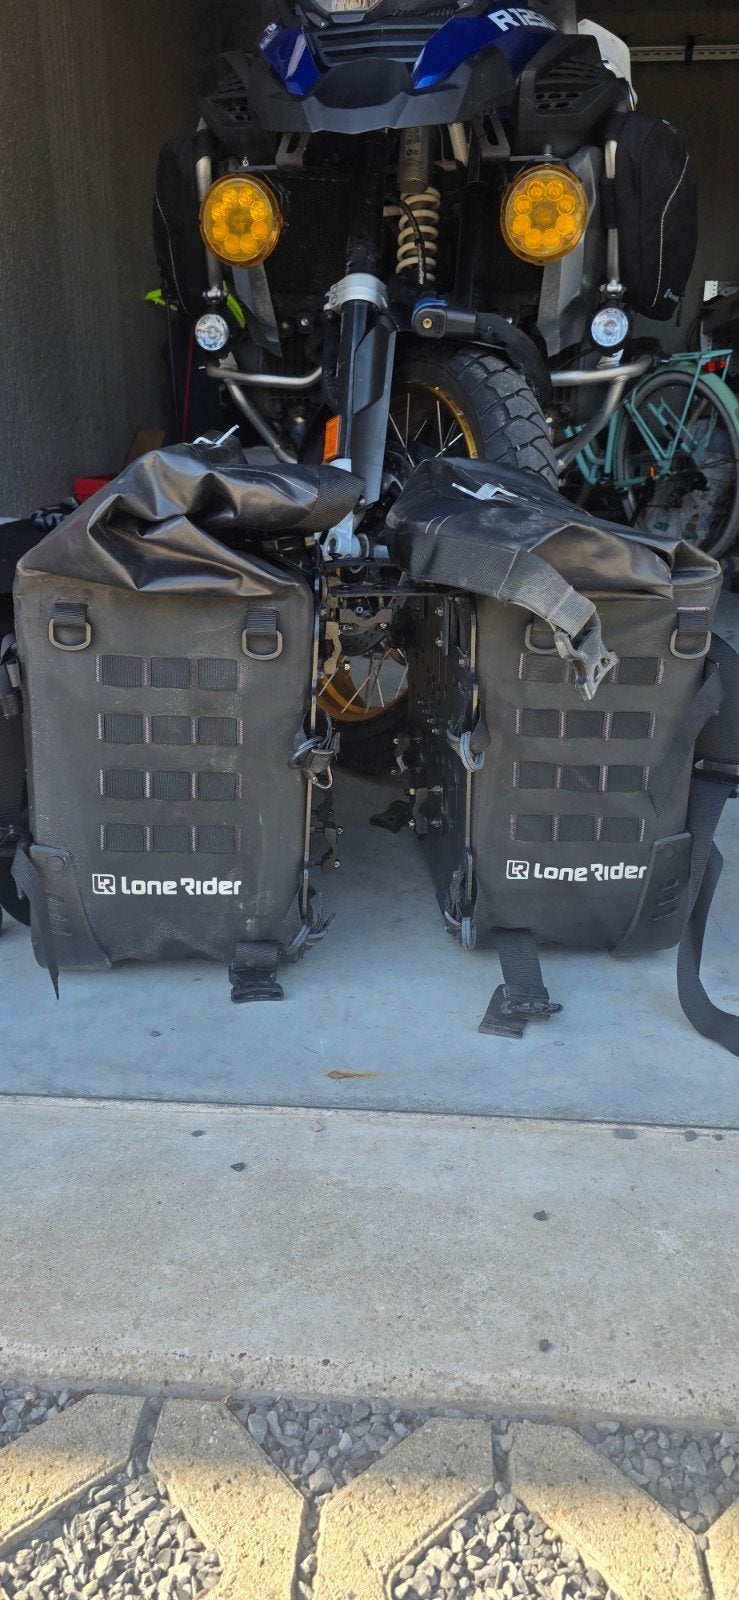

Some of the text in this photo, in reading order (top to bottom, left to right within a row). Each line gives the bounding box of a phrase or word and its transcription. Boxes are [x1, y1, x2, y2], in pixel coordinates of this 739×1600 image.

[533, 862, 588, 882] Lone
[590, 862, 647, 881] Rider
[121, 876, 178, 895] Lone
[180, 877, 242, 895] Rider
